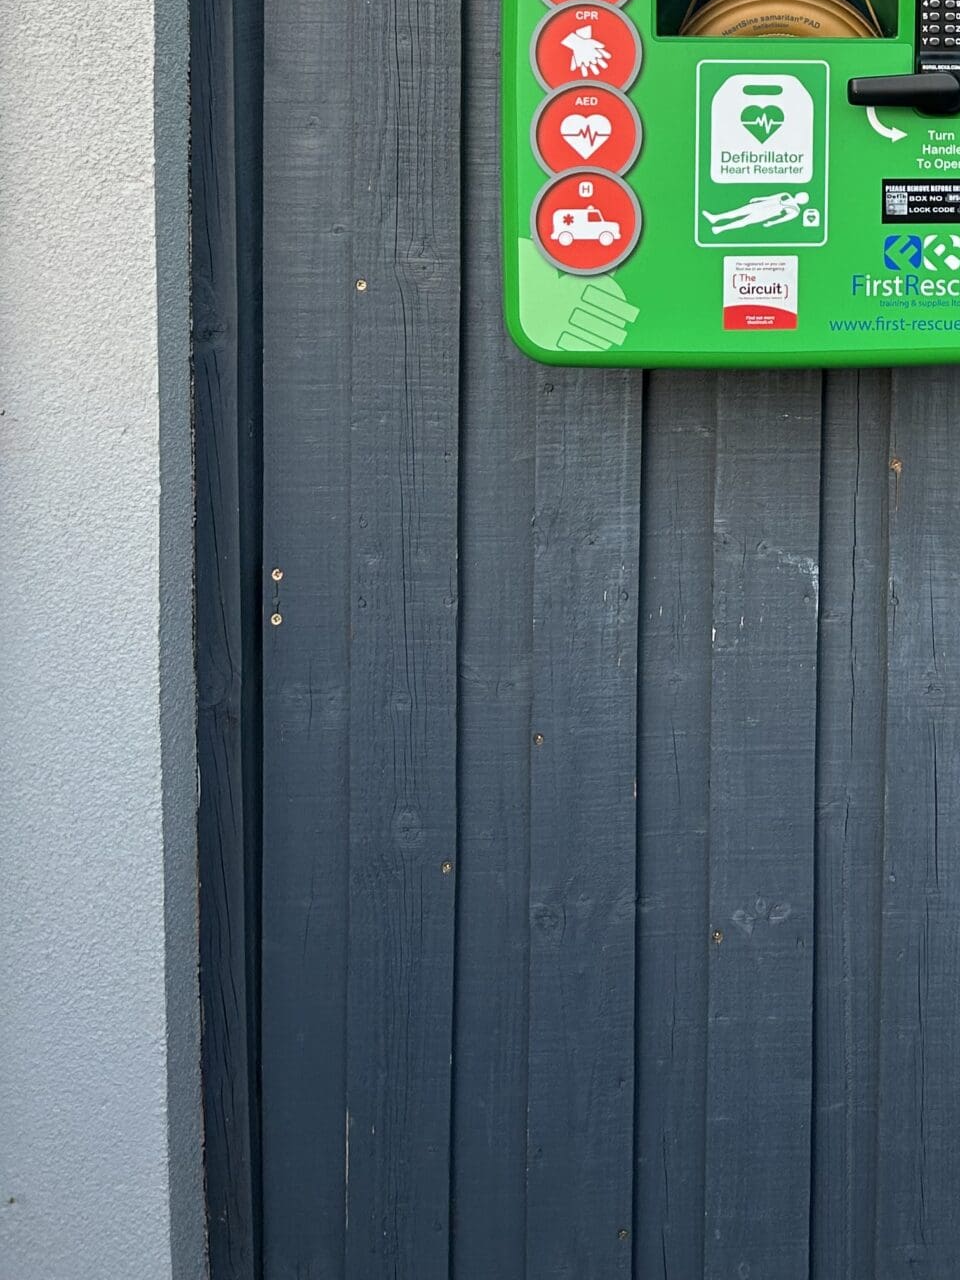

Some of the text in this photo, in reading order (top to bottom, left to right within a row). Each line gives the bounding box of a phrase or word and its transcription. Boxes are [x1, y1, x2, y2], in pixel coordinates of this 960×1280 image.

[576, 11, 598, 20] CPR
[804, 18, 821, 29] PAD
[575, 97, 598, 106] AED
[928, 130, 955, 141] Turn
[721, 151, 804, 164] Defibrillator
[917, 158, 931, 169] To
[720, 165, 803, 174] Heart Restarter
[582, 185, 590, 194] H
[739, 274, 756, 282] The
[739, 283, 782, 295] circuit
[880, 299, 909, 308] training
[919, 300, 949, 308] supplies
